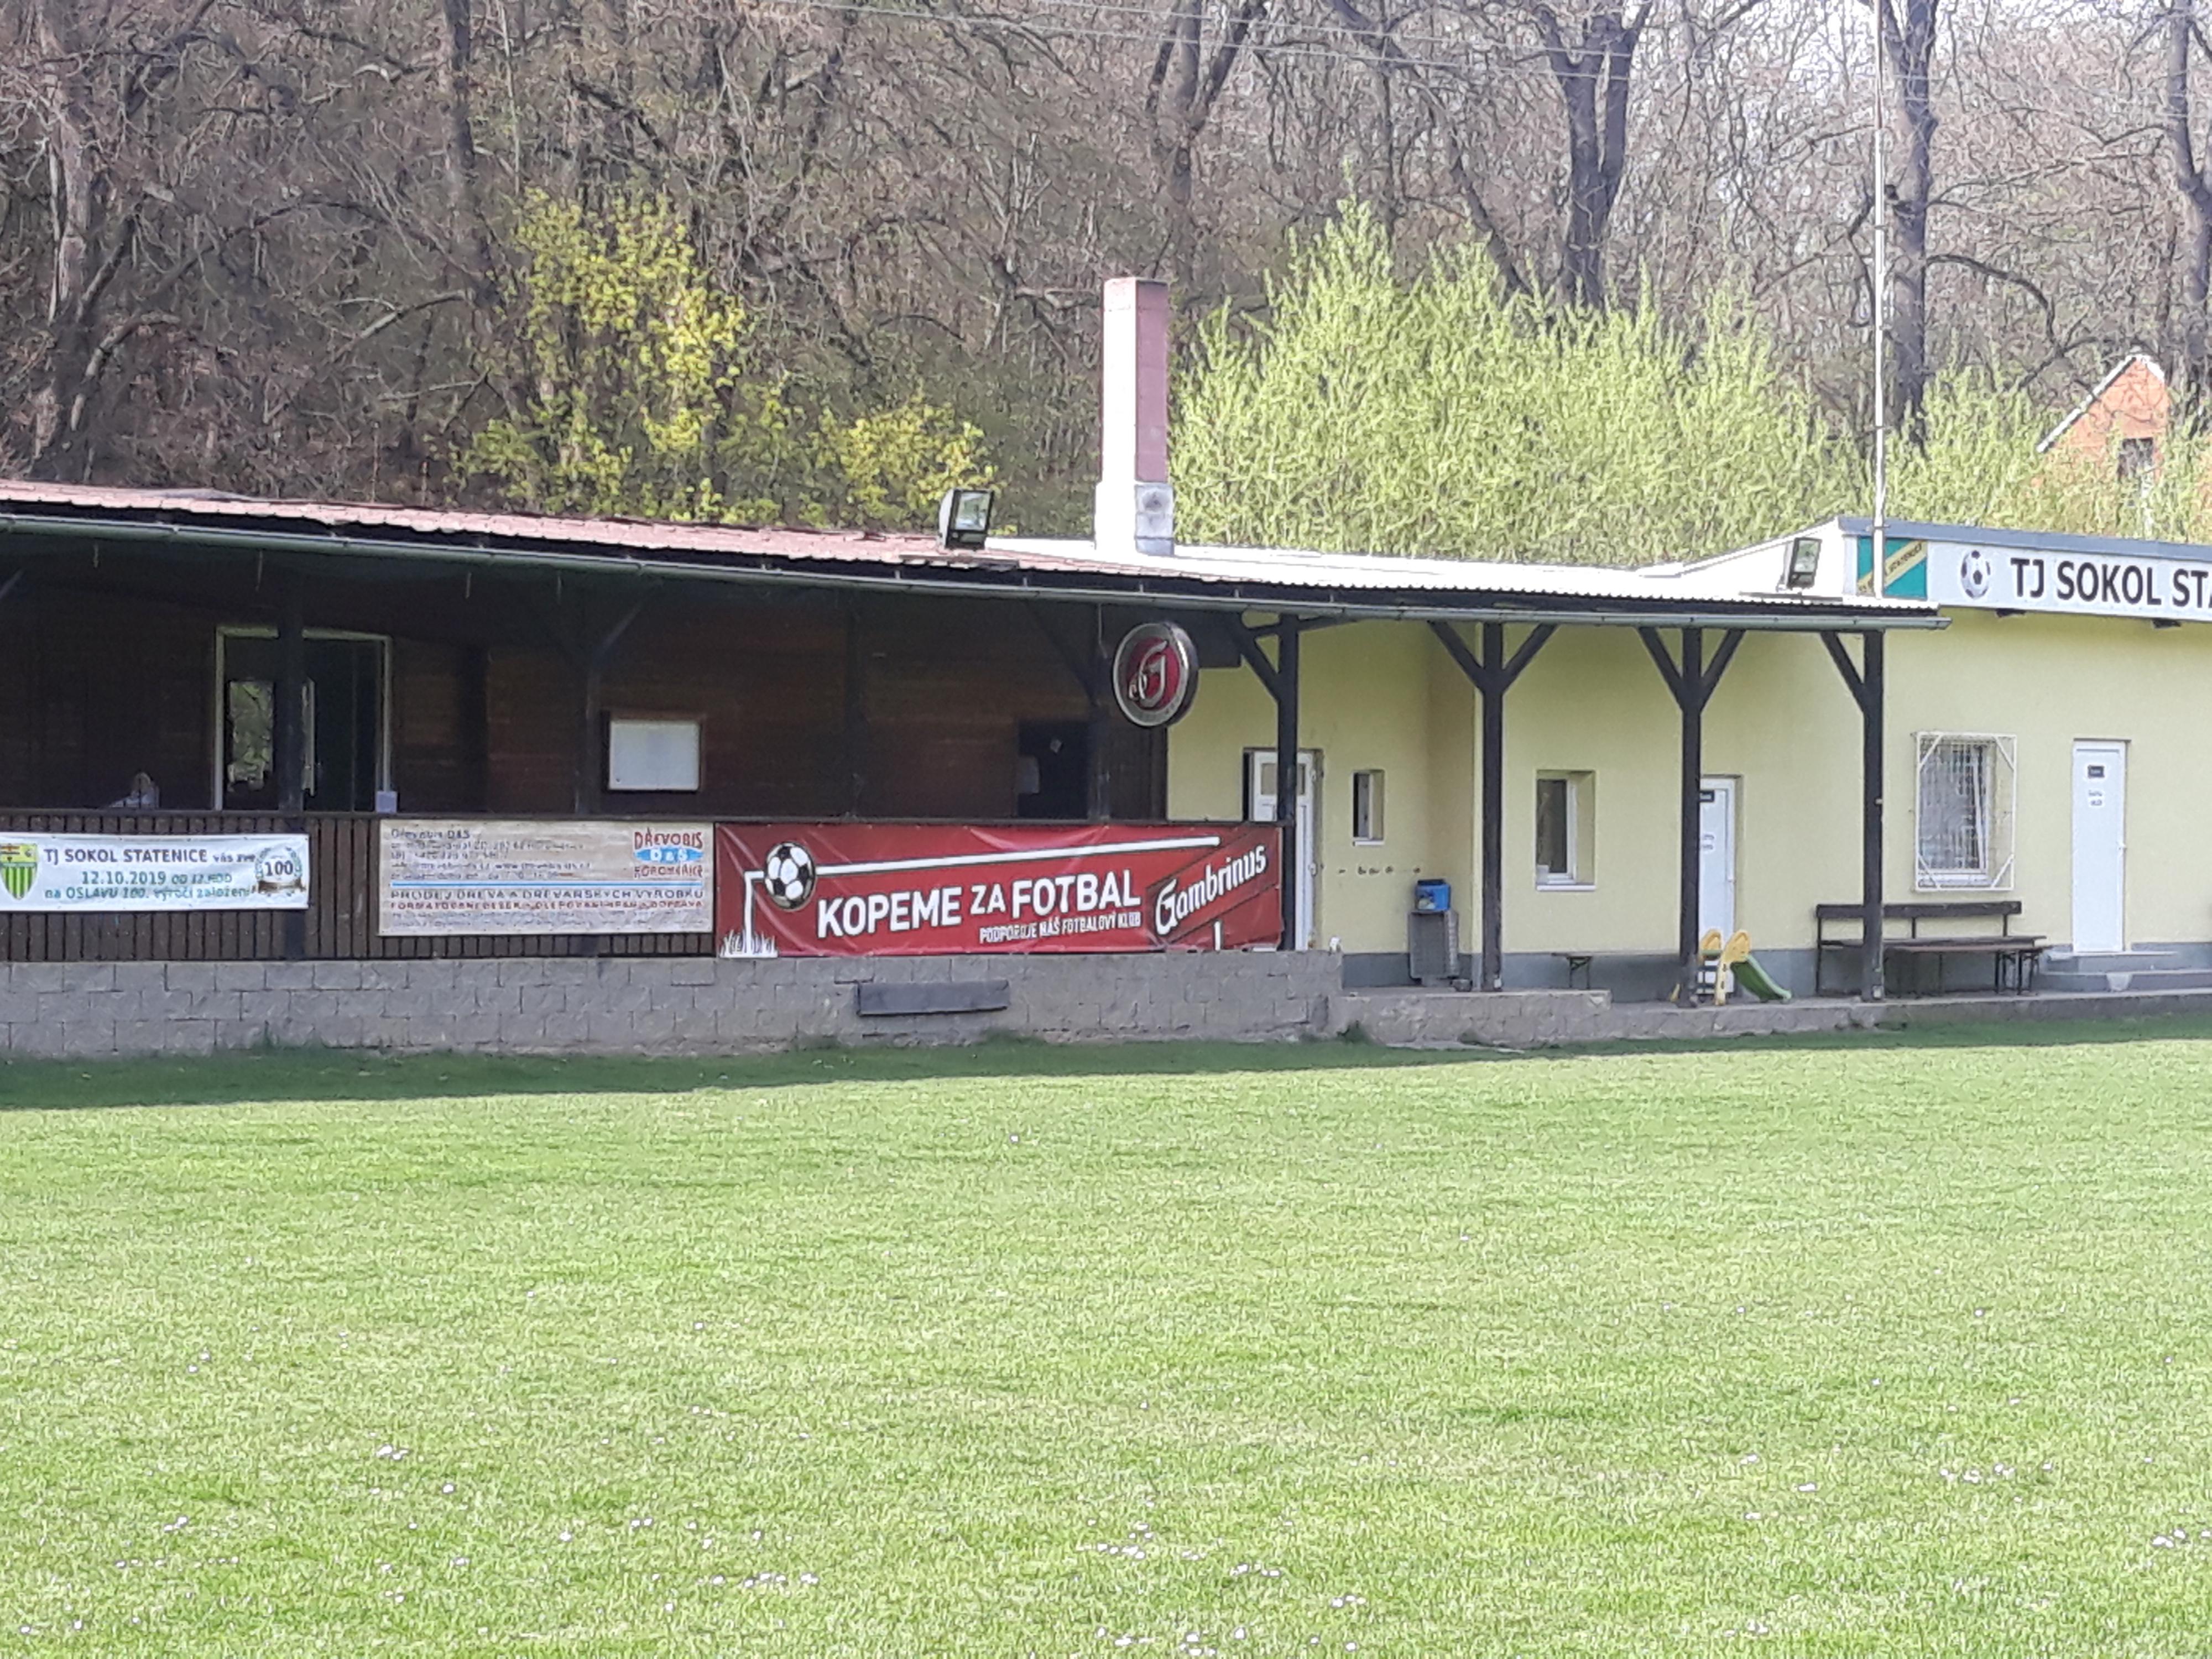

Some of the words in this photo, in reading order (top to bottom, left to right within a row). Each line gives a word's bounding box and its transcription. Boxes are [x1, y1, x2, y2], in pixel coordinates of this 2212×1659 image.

[2010, 557, 2044, 598] TJ
[2057, 561, 2162, 605] SOKOL
[2172, 568, 2212, 608] ST
[44, 849, 58, 865] TJ
[65, 849, 118, 863] SOKOL
[123, 849, 207, 863] STATENICE
[264, 860, 294, 877] 100
[82, 870, 166, 885] 12.10.2019
[66, 886, 118, 899] OSLAVU
[1155, 845, 1266, 935] Gambrinus
[817, 886, 963, 938] KOPEME
[970, 883, 1006, 915] ZA
[1011, 869, 1141, 919] FOTBAL
